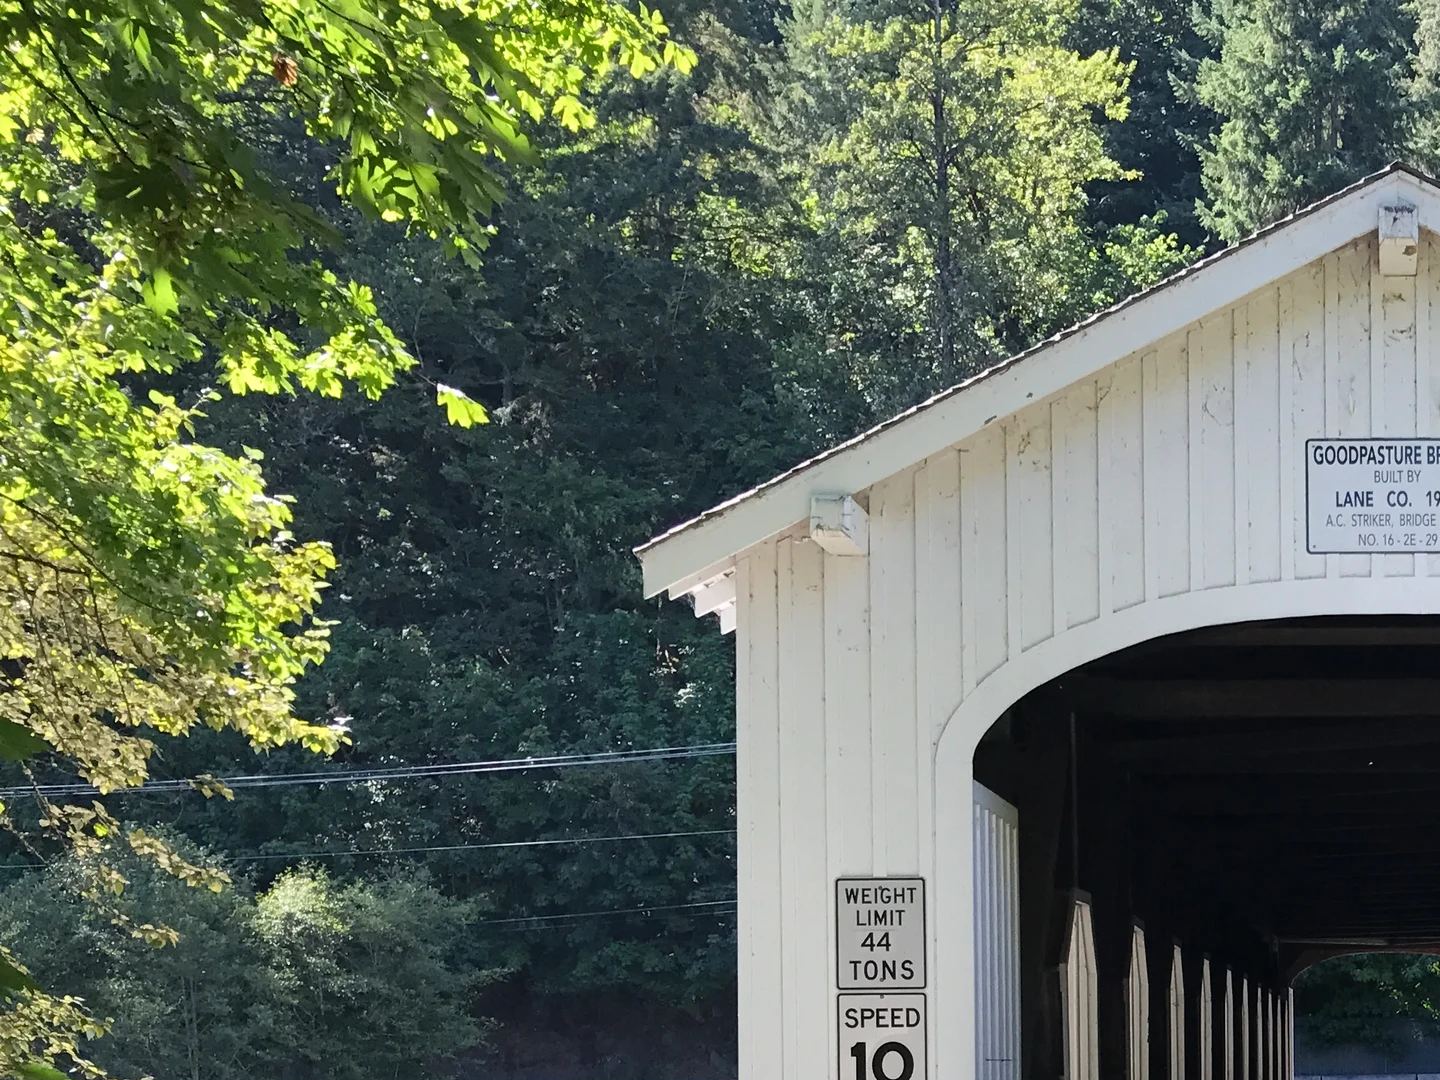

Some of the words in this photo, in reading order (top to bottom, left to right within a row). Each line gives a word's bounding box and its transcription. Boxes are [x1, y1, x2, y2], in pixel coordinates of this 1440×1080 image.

[1313, 445, 1422, 465] GOODPASTURE
[1374, 470, 1404, 483] BUILT
[1407, 470, 1421, 483] BY
[1336, 491, 1373, 507] LANE
[1387, 491, 1412, 507] CO.
[1326, 514, 1345, 527] A.C.
[1352, 514, 1394, 528] STRIKER,
[1400, 514, 1436, 526] BRIDGE
[1358, 534, 1378, 546] NO.
[845, 887, 916, 904] WEIGHT
[856, 910, 905, 926] LIMIT
[861, 932, 891, 951] 44
[849, 960, 914, 980] TONS
[845, 1008, 920, 1028] SPEED
